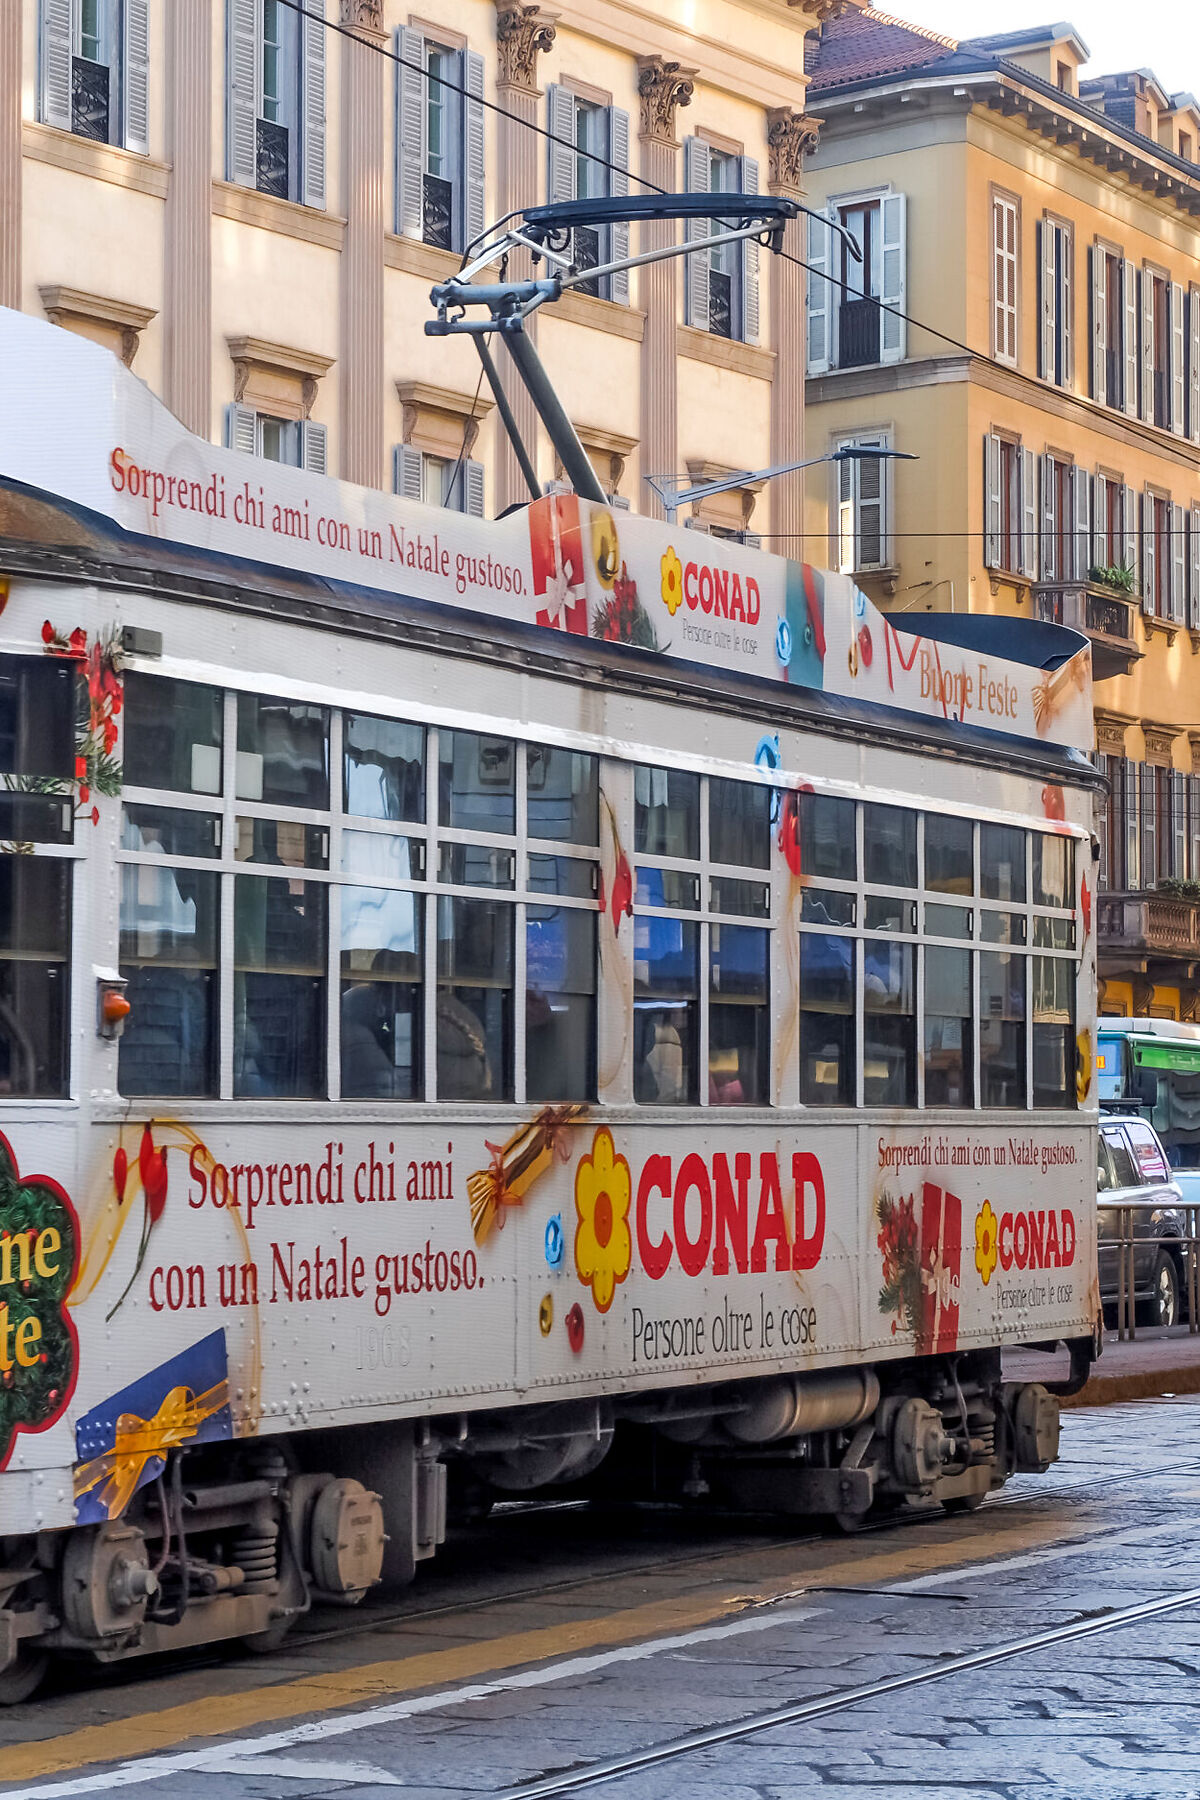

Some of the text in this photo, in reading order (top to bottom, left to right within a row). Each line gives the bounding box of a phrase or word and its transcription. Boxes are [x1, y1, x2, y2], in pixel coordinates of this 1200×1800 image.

[111, 447, 527, 596] Sorprendi chi ami con un Natale gustoso.
[683, 561, 760, 625] CONAD
[920, 649, 1018, 719] Buone Feste
[188, 1141, 454, 1229] Sorprendi chi ami
[878, 1136, 1077, 1176] Sorprendi chi ami con un Natale gustoso.
[636, 1152, 826, 1281] CONAD
[999, 1209, 1076, 1271] CONAD
[149, 1236, 485, 1317] con un Natale gustoso.
[355, 1323, 411, 1371] 1968
[631, 1292, 817, 1362] Persone oltre le cose
